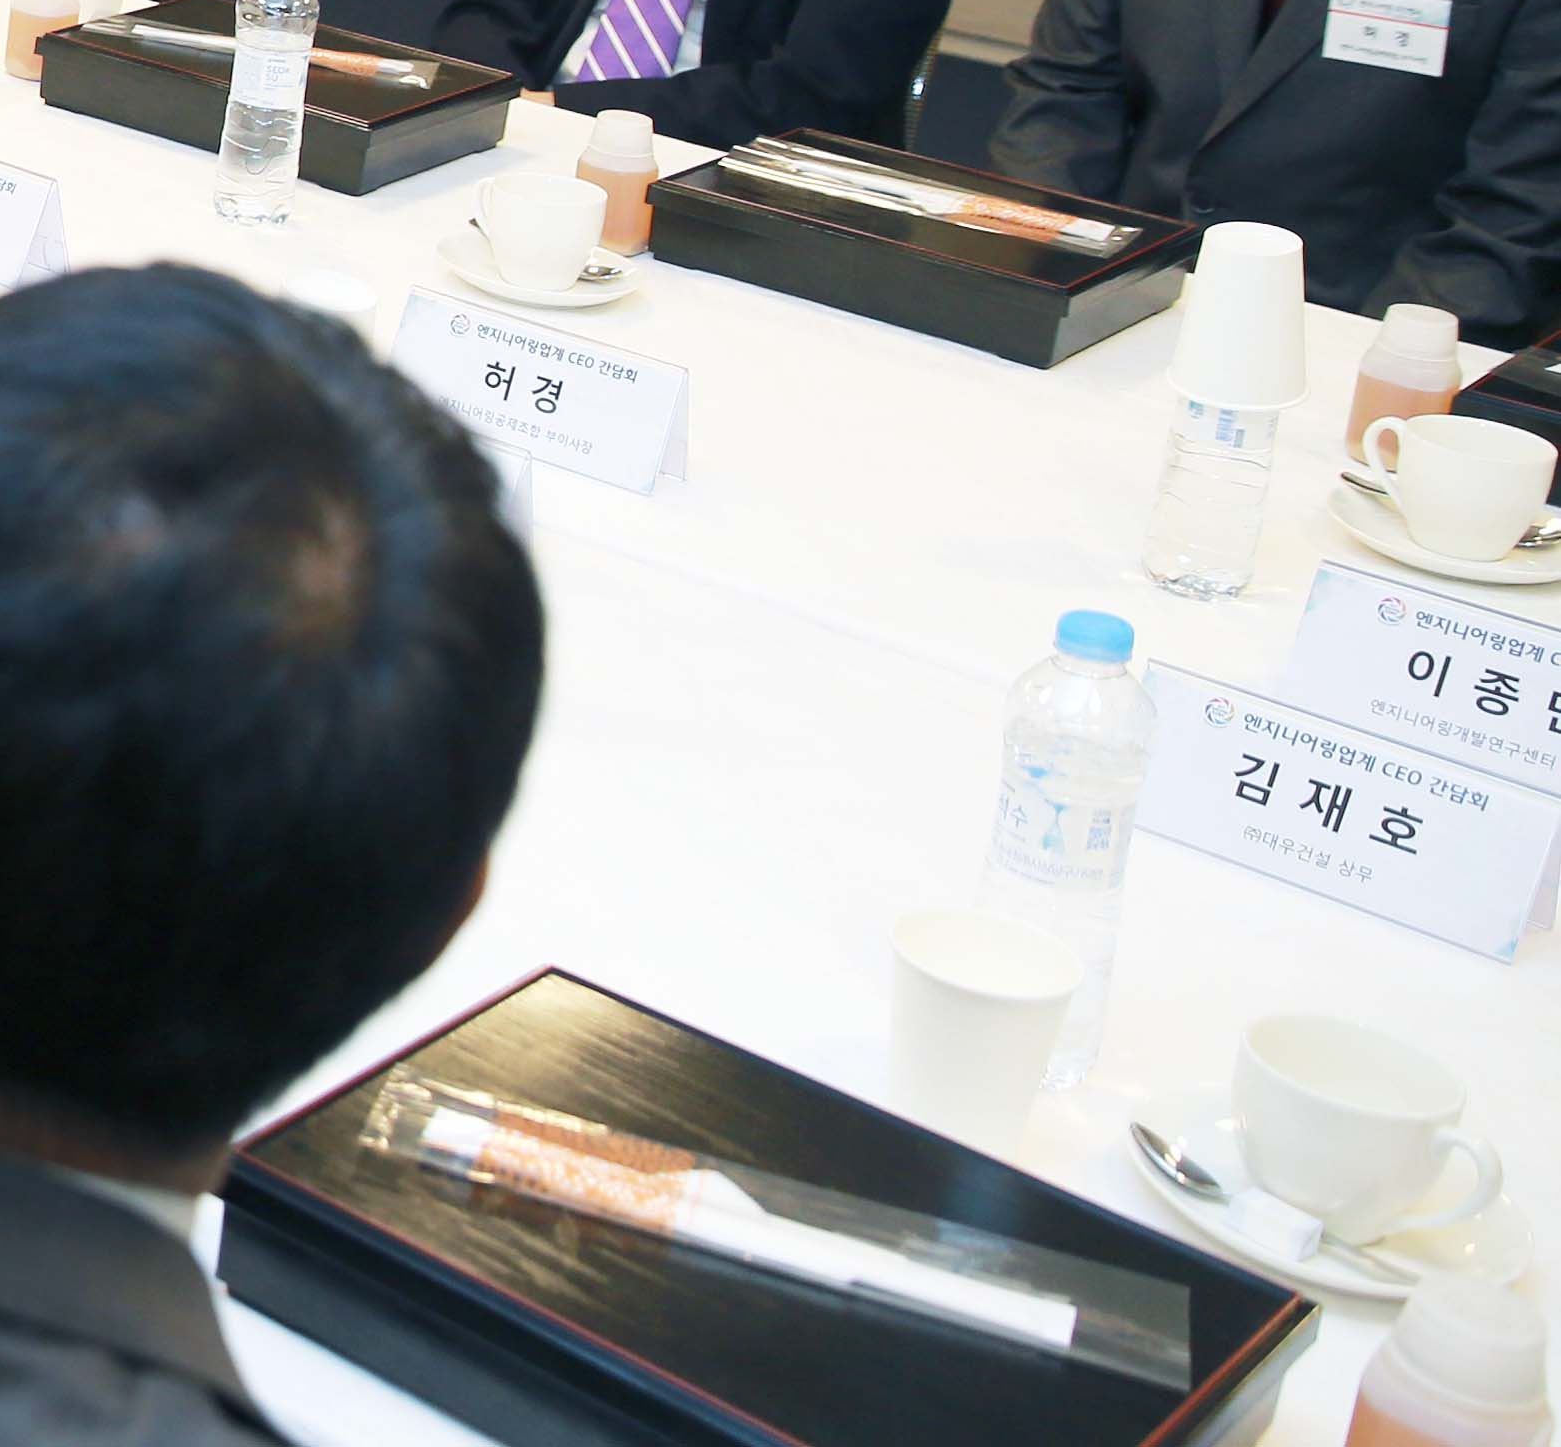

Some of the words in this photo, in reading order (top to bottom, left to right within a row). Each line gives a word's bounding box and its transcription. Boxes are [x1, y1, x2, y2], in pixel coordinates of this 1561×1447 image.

[476, 322, 566, 362] 엔지니어링업계
[567, 351, 596, 370] CEO
[597, 359, 640, 384] 간담회
[1414, 609, 1546, 664] 엔지니어링업계
[1243, 711, 1378, 774] 엔지니어링업계
[1380, 760, 1424, 787] CEO
[1428, 775, 1491, 812] 간담회
[1369, 697, 1559, 771] 엔지니어링개발연구센터
[1337, 857, 1378, 884] 상무
